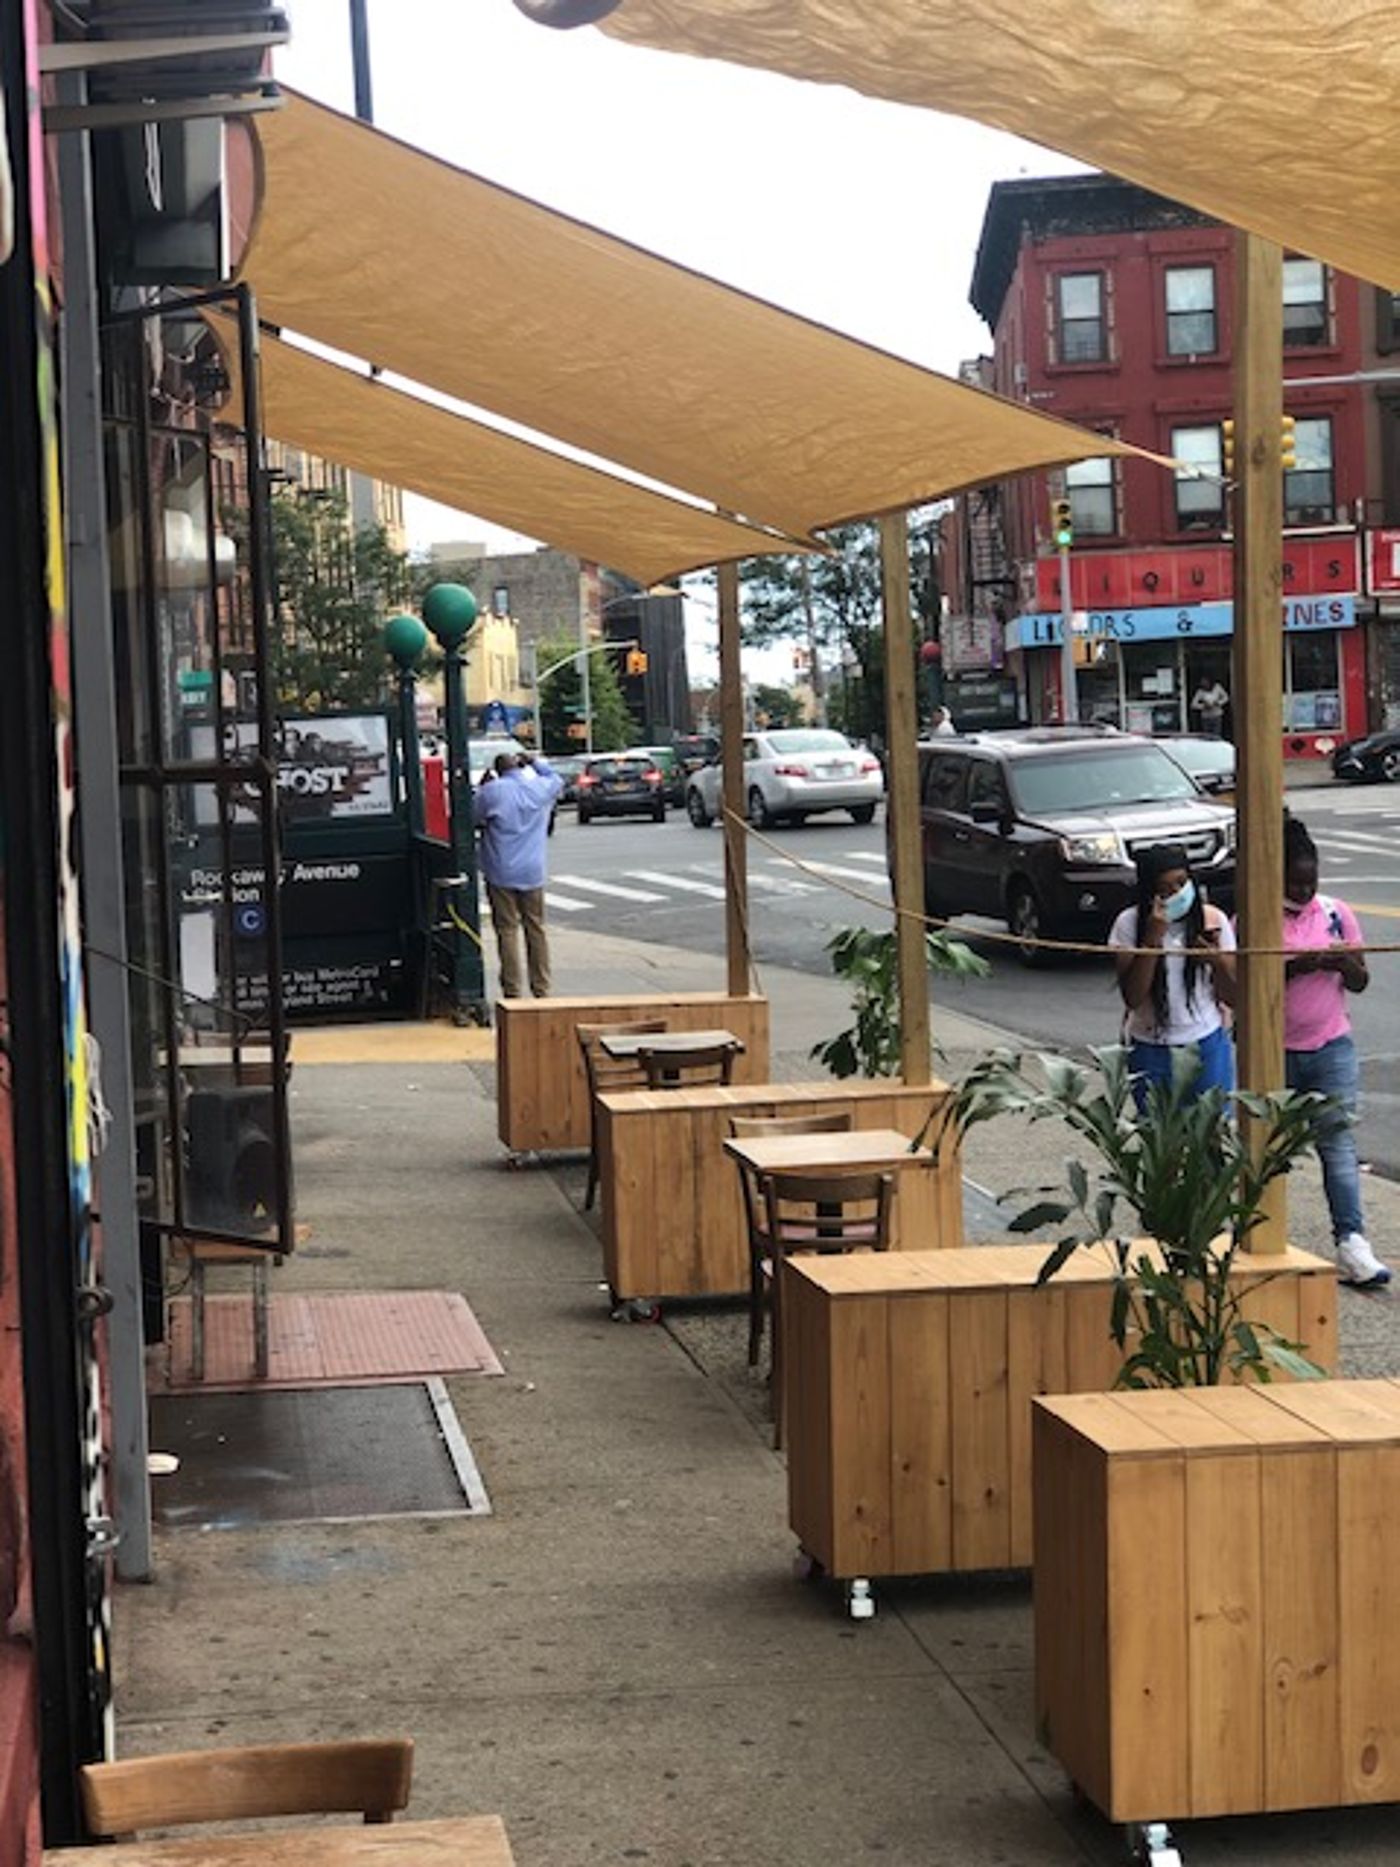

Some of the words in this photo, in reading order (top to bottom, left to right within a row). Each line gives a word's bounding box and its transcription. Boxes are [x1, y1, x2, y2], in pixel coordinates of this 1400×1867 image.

[1177, 610, 1195, 634] &
[293, 862, 360, 882] Avenue
[241, 909, 260, 930] C
